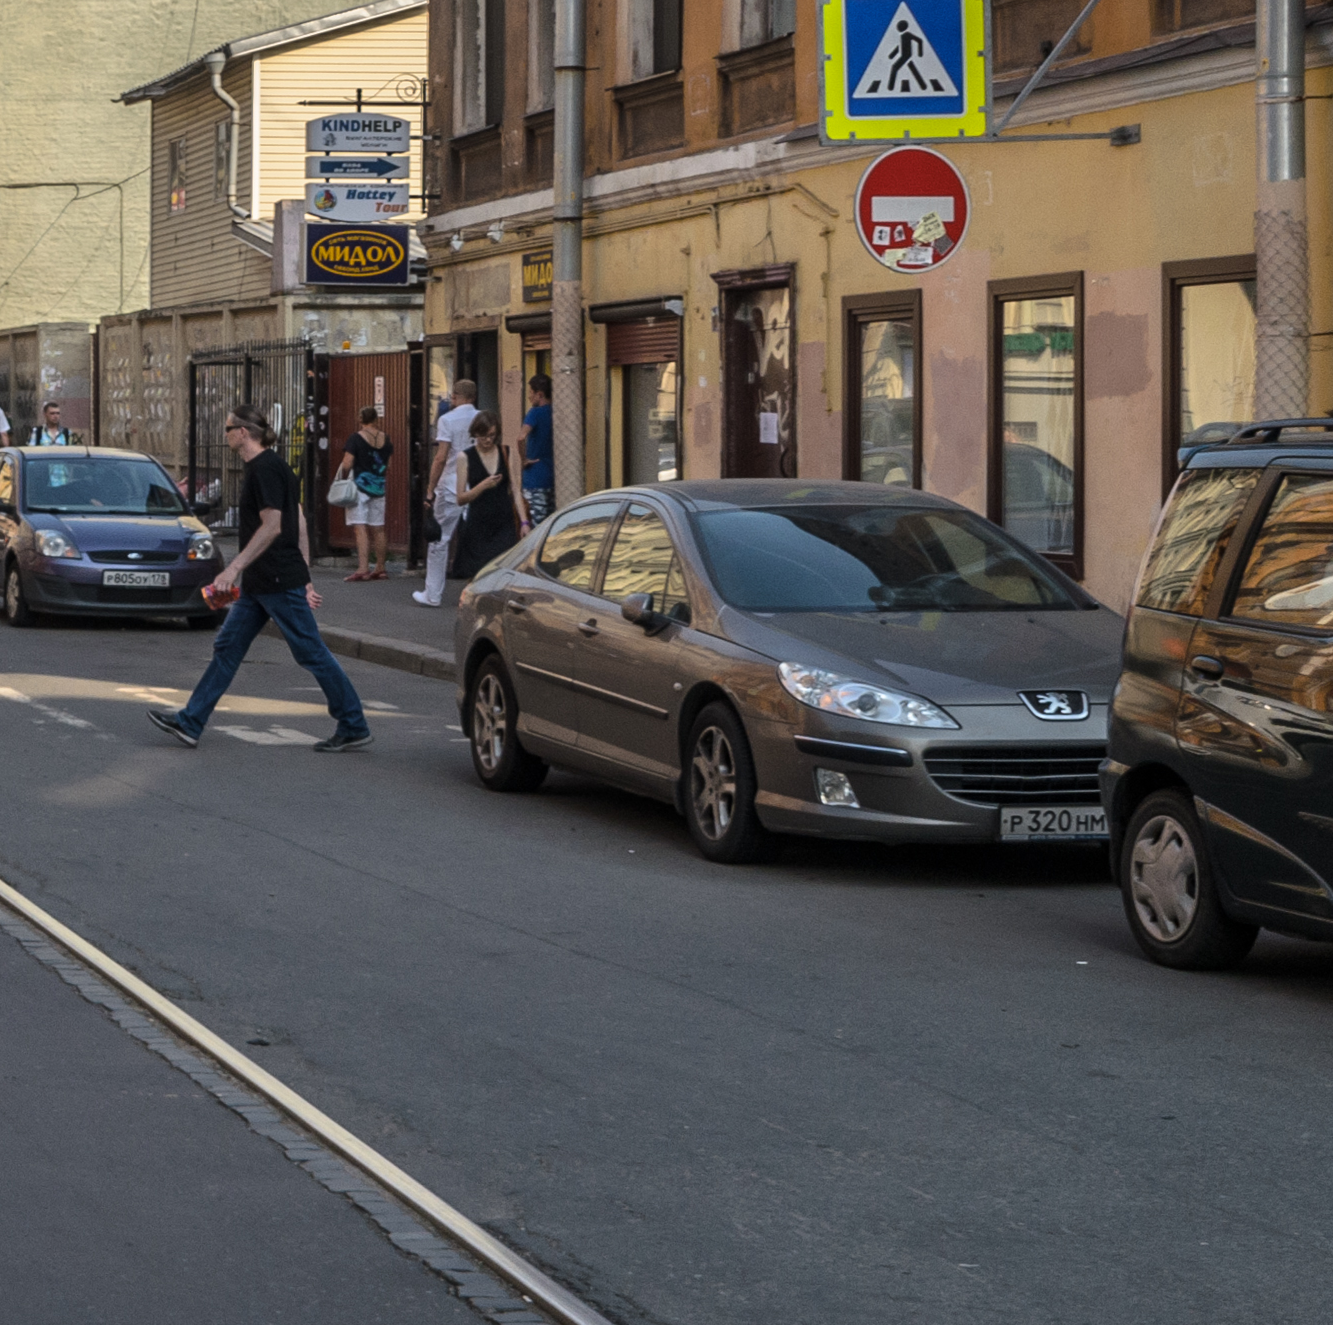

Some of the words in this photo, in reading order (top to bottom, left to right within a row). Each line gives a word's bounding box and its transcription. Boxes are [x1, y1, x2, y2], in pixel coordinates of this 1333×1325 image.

[321, 119, 402, 133] KINDHELP
[345, 189, 397, 202] Hottey
[375, 202, 408, 213] Tour
[318, 245, 398, 266] МИДОЛ
[523, 261, 553, 288] МИДО
